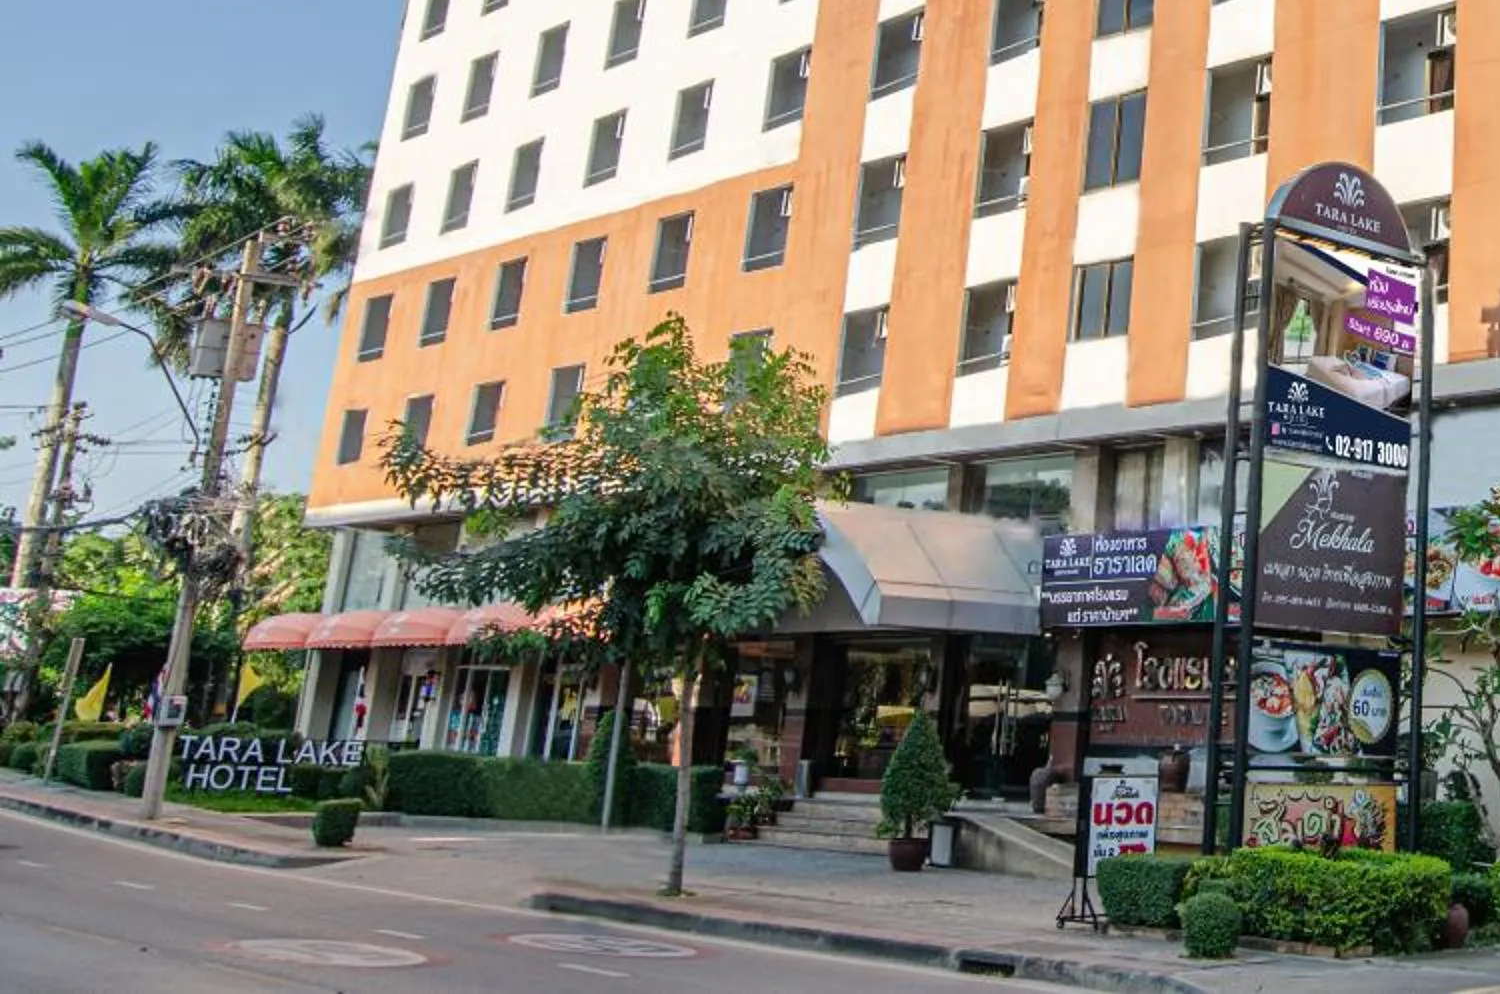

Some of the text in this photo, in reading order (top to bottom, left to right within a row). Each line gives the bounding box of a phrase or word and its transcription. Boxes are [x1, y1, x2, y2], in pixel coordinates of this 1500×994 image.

[1315, 203, 1348, 224] TARA
[1350, 214, 1381, 233] LAKE
[1267, 401, 1325, 418] TARA LAKE
[1095, 535, 1148, 552] ห้องอาหาร
[1290, 519, 1375, 553] Mekhala
[1045, 558, 1067, 570] TARA
[1069, 557, 1090, 569] LAKE
[1093, 553, 1157, 575] ธาราเลค
[1353, 700, 1369, 717] 60
[179, 735, 364, 766] TARA LAKE
[185, 763, 293, 792] HOTEL
[1093, 801, 1154, 826] นวด
[1108, 847, 1115, 857] 2
